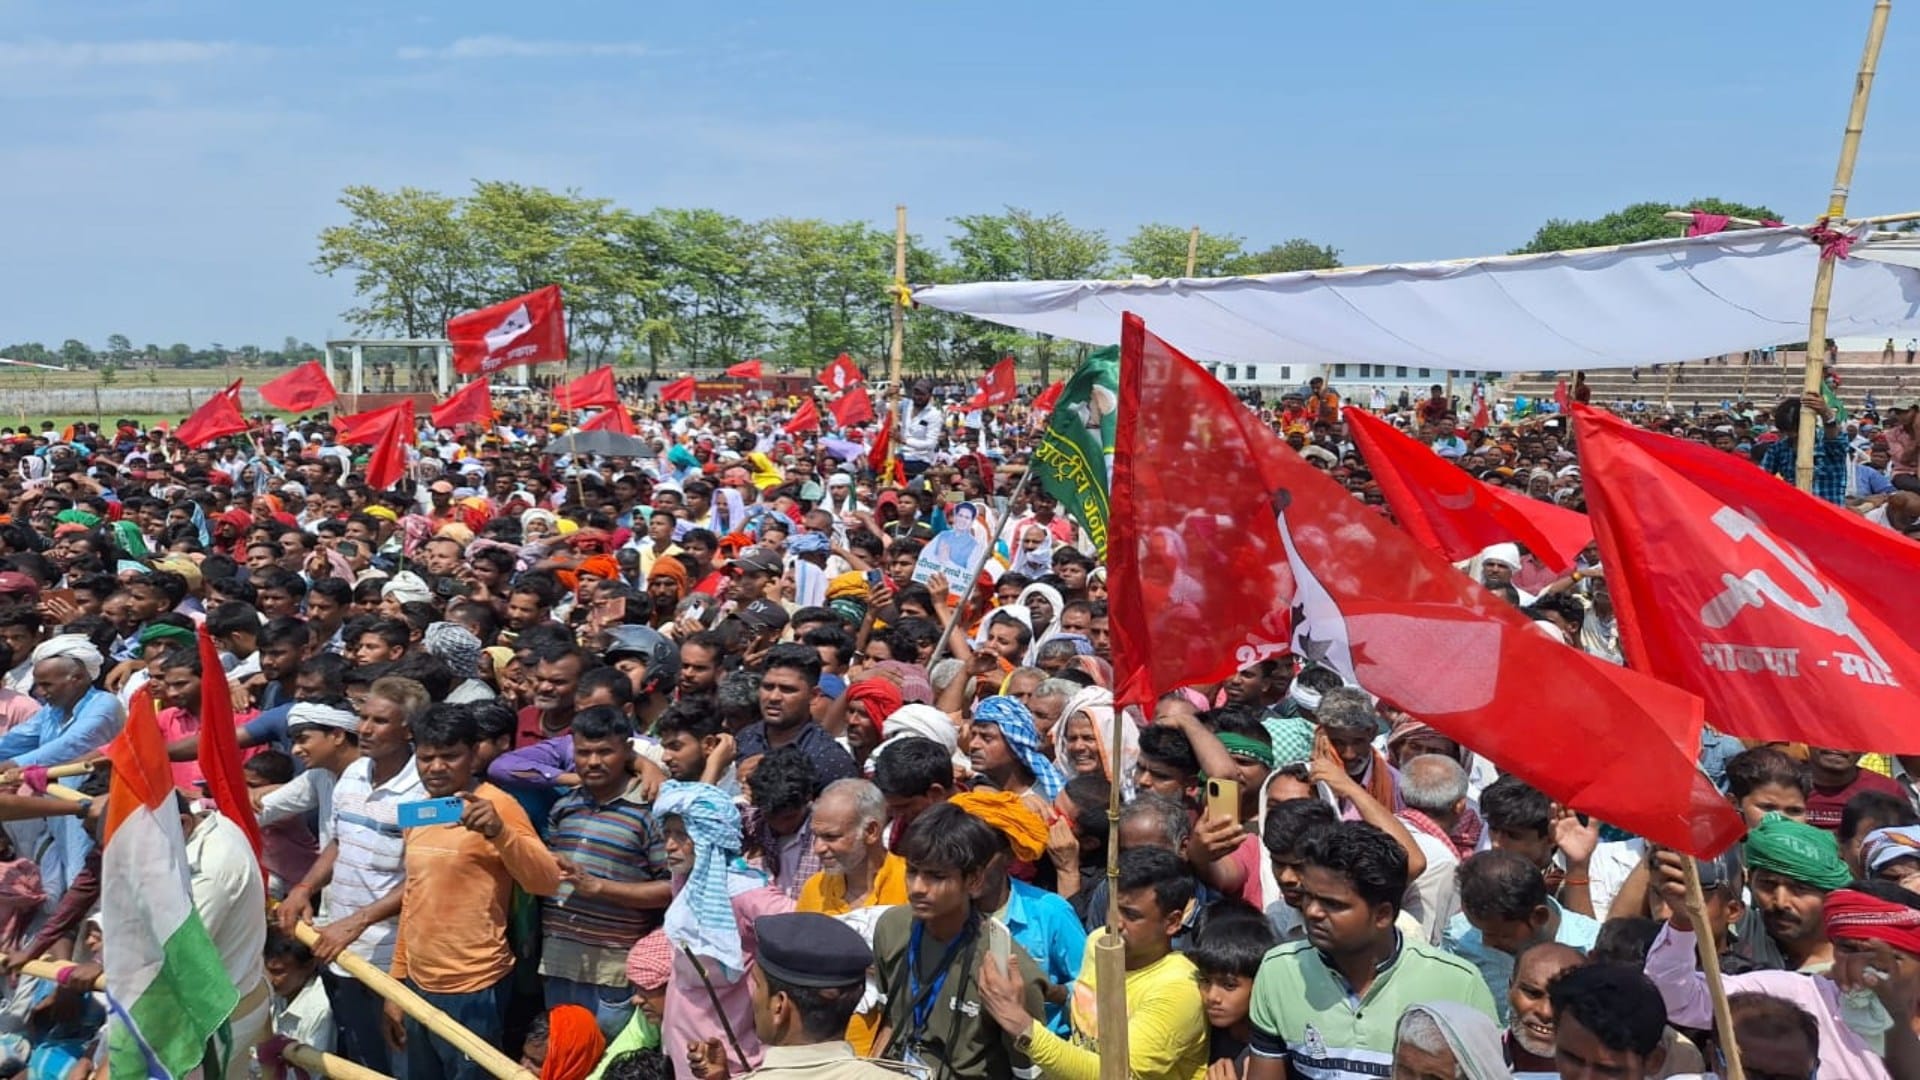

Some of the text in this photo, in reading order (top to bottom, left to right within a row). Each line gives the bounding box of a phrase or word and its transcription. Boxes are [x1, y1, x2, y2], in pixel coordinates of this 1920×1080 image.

[1034, 440, 1091, 494] राष्ट्रीय
[1700, 642, 1801, 678] भाकपा
[1832, 650, 1901, 688] मा
